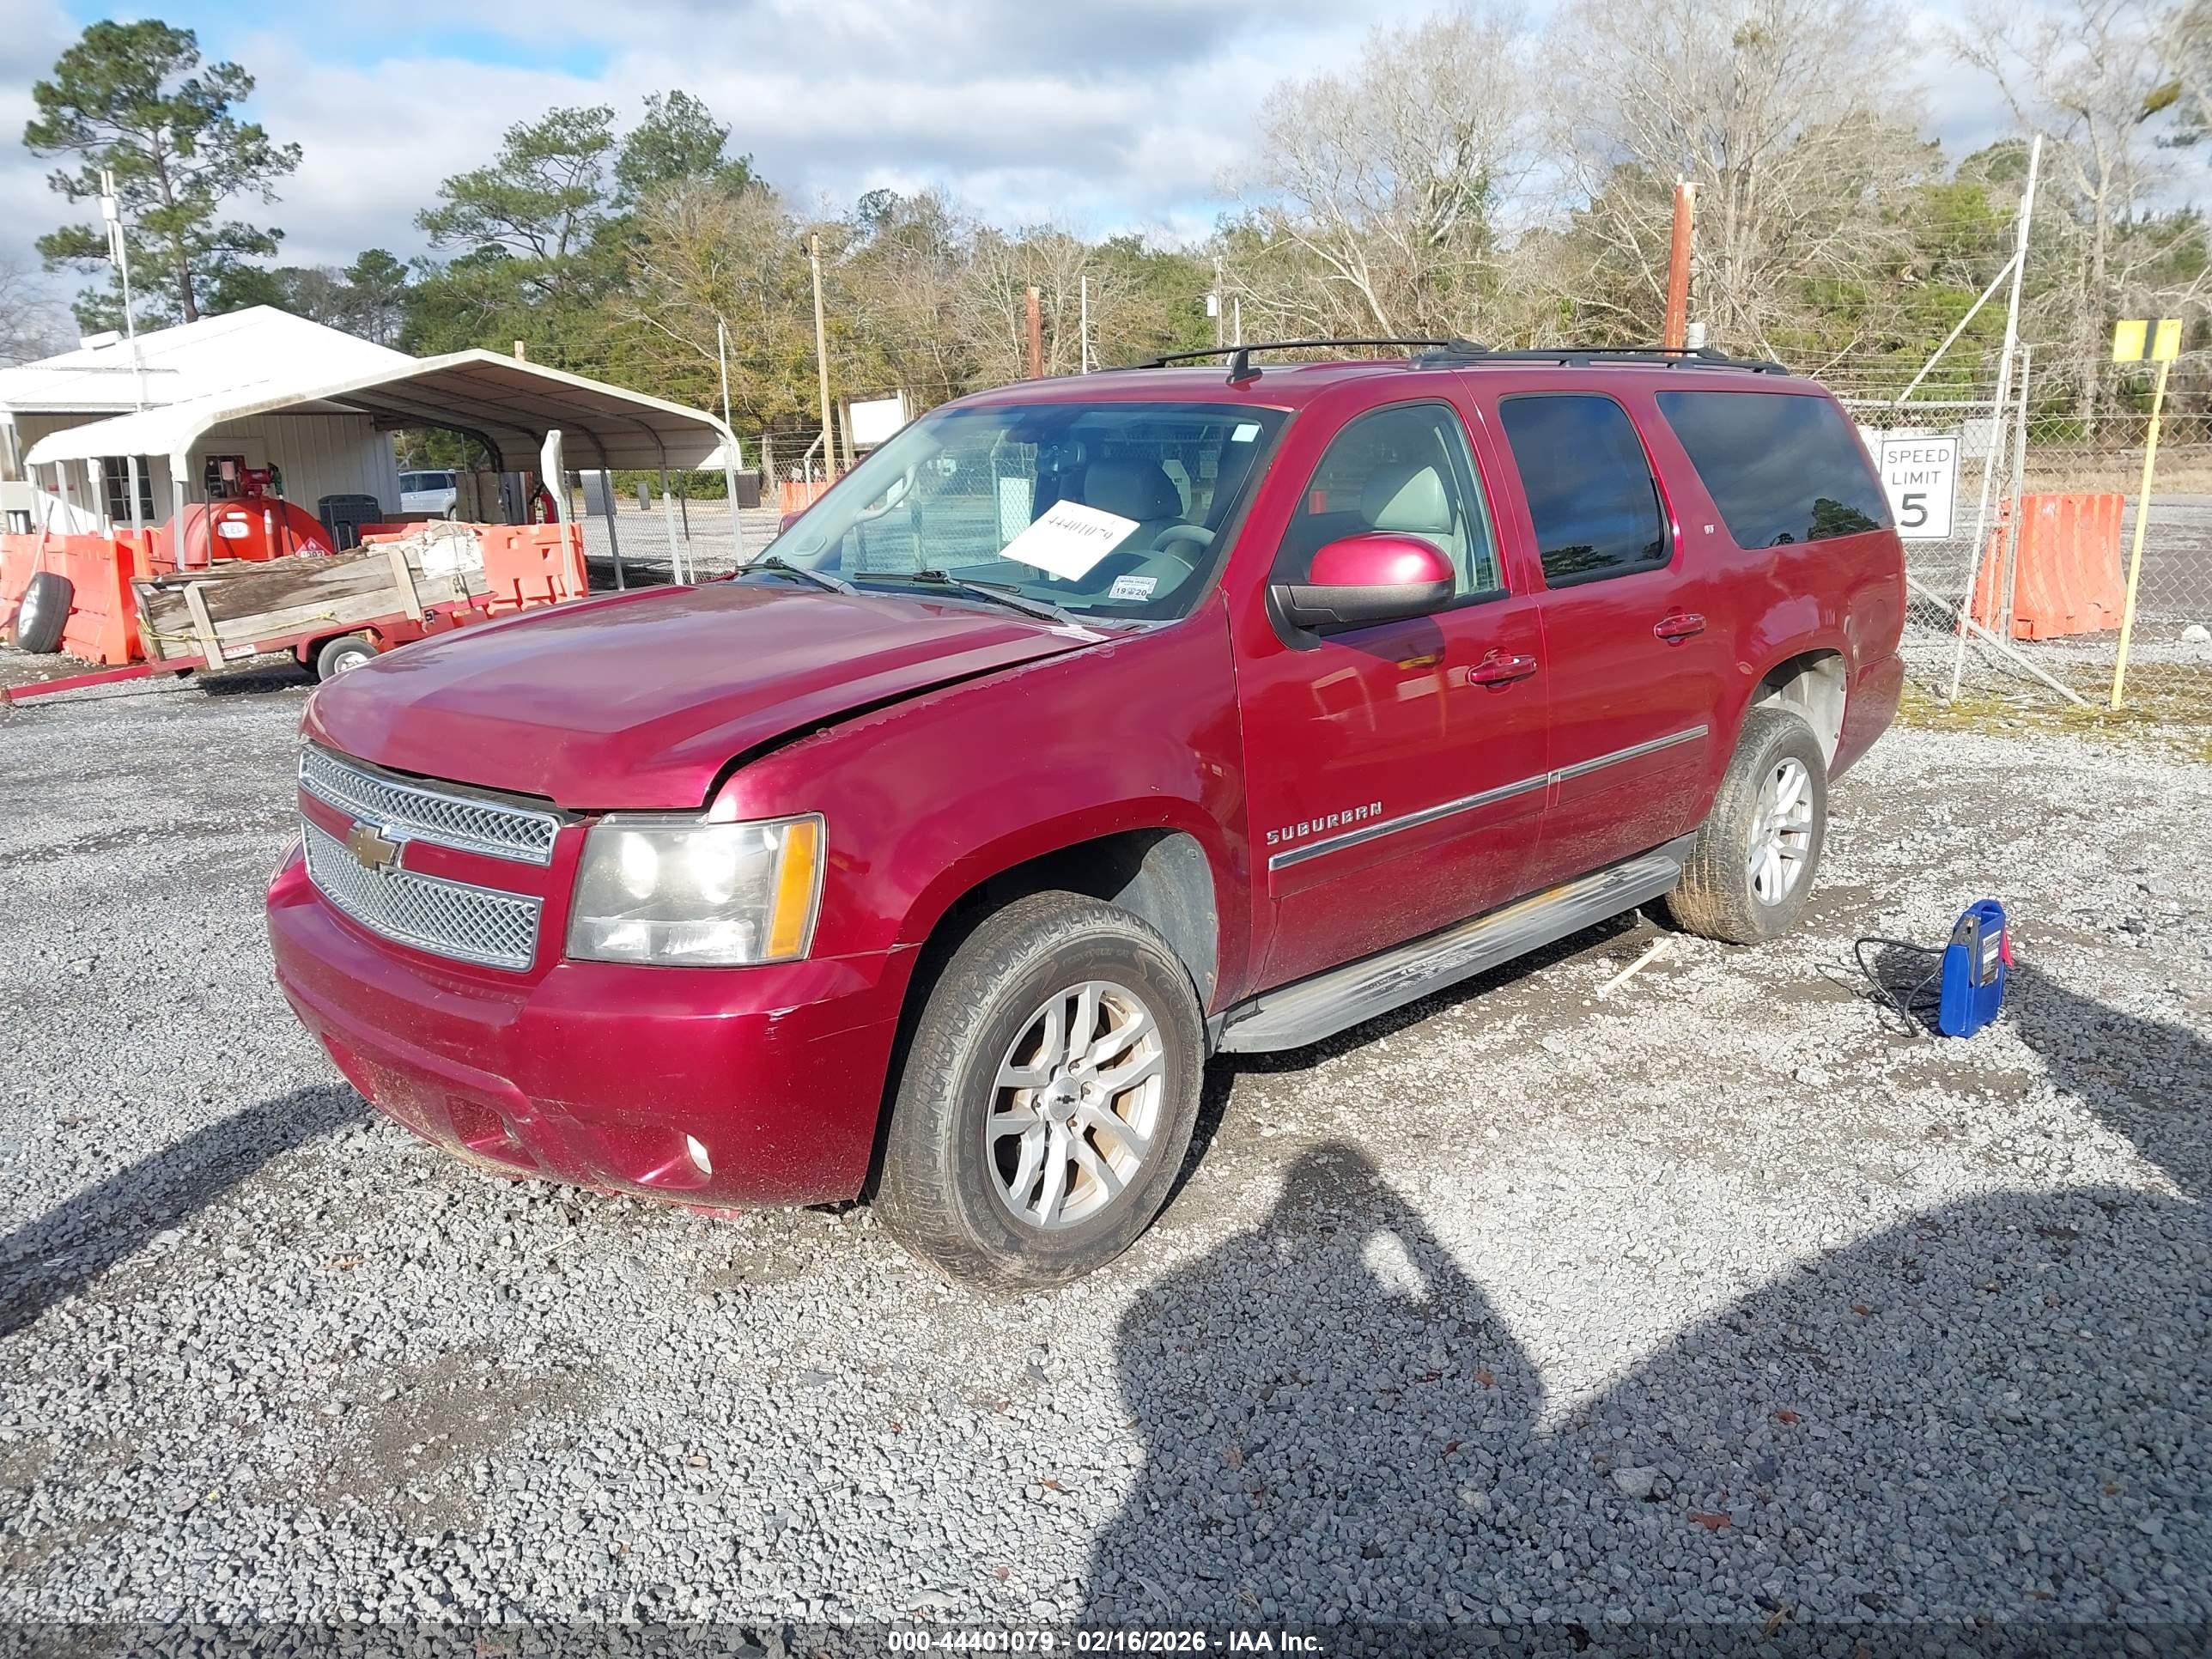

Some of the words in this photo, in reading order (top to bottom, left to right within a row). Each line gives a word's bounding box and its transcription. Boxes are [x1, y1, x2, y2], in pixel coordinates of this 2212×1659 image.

[1887, 448, 1950, 464] SPEED
[1892, 471, 1942, 485] LIMIT
[1900, 493, 1929, 527] 5
[1048, 516, 1114, 540] 44401079
[1266, 800, 1382, 846] SUBURBAN
